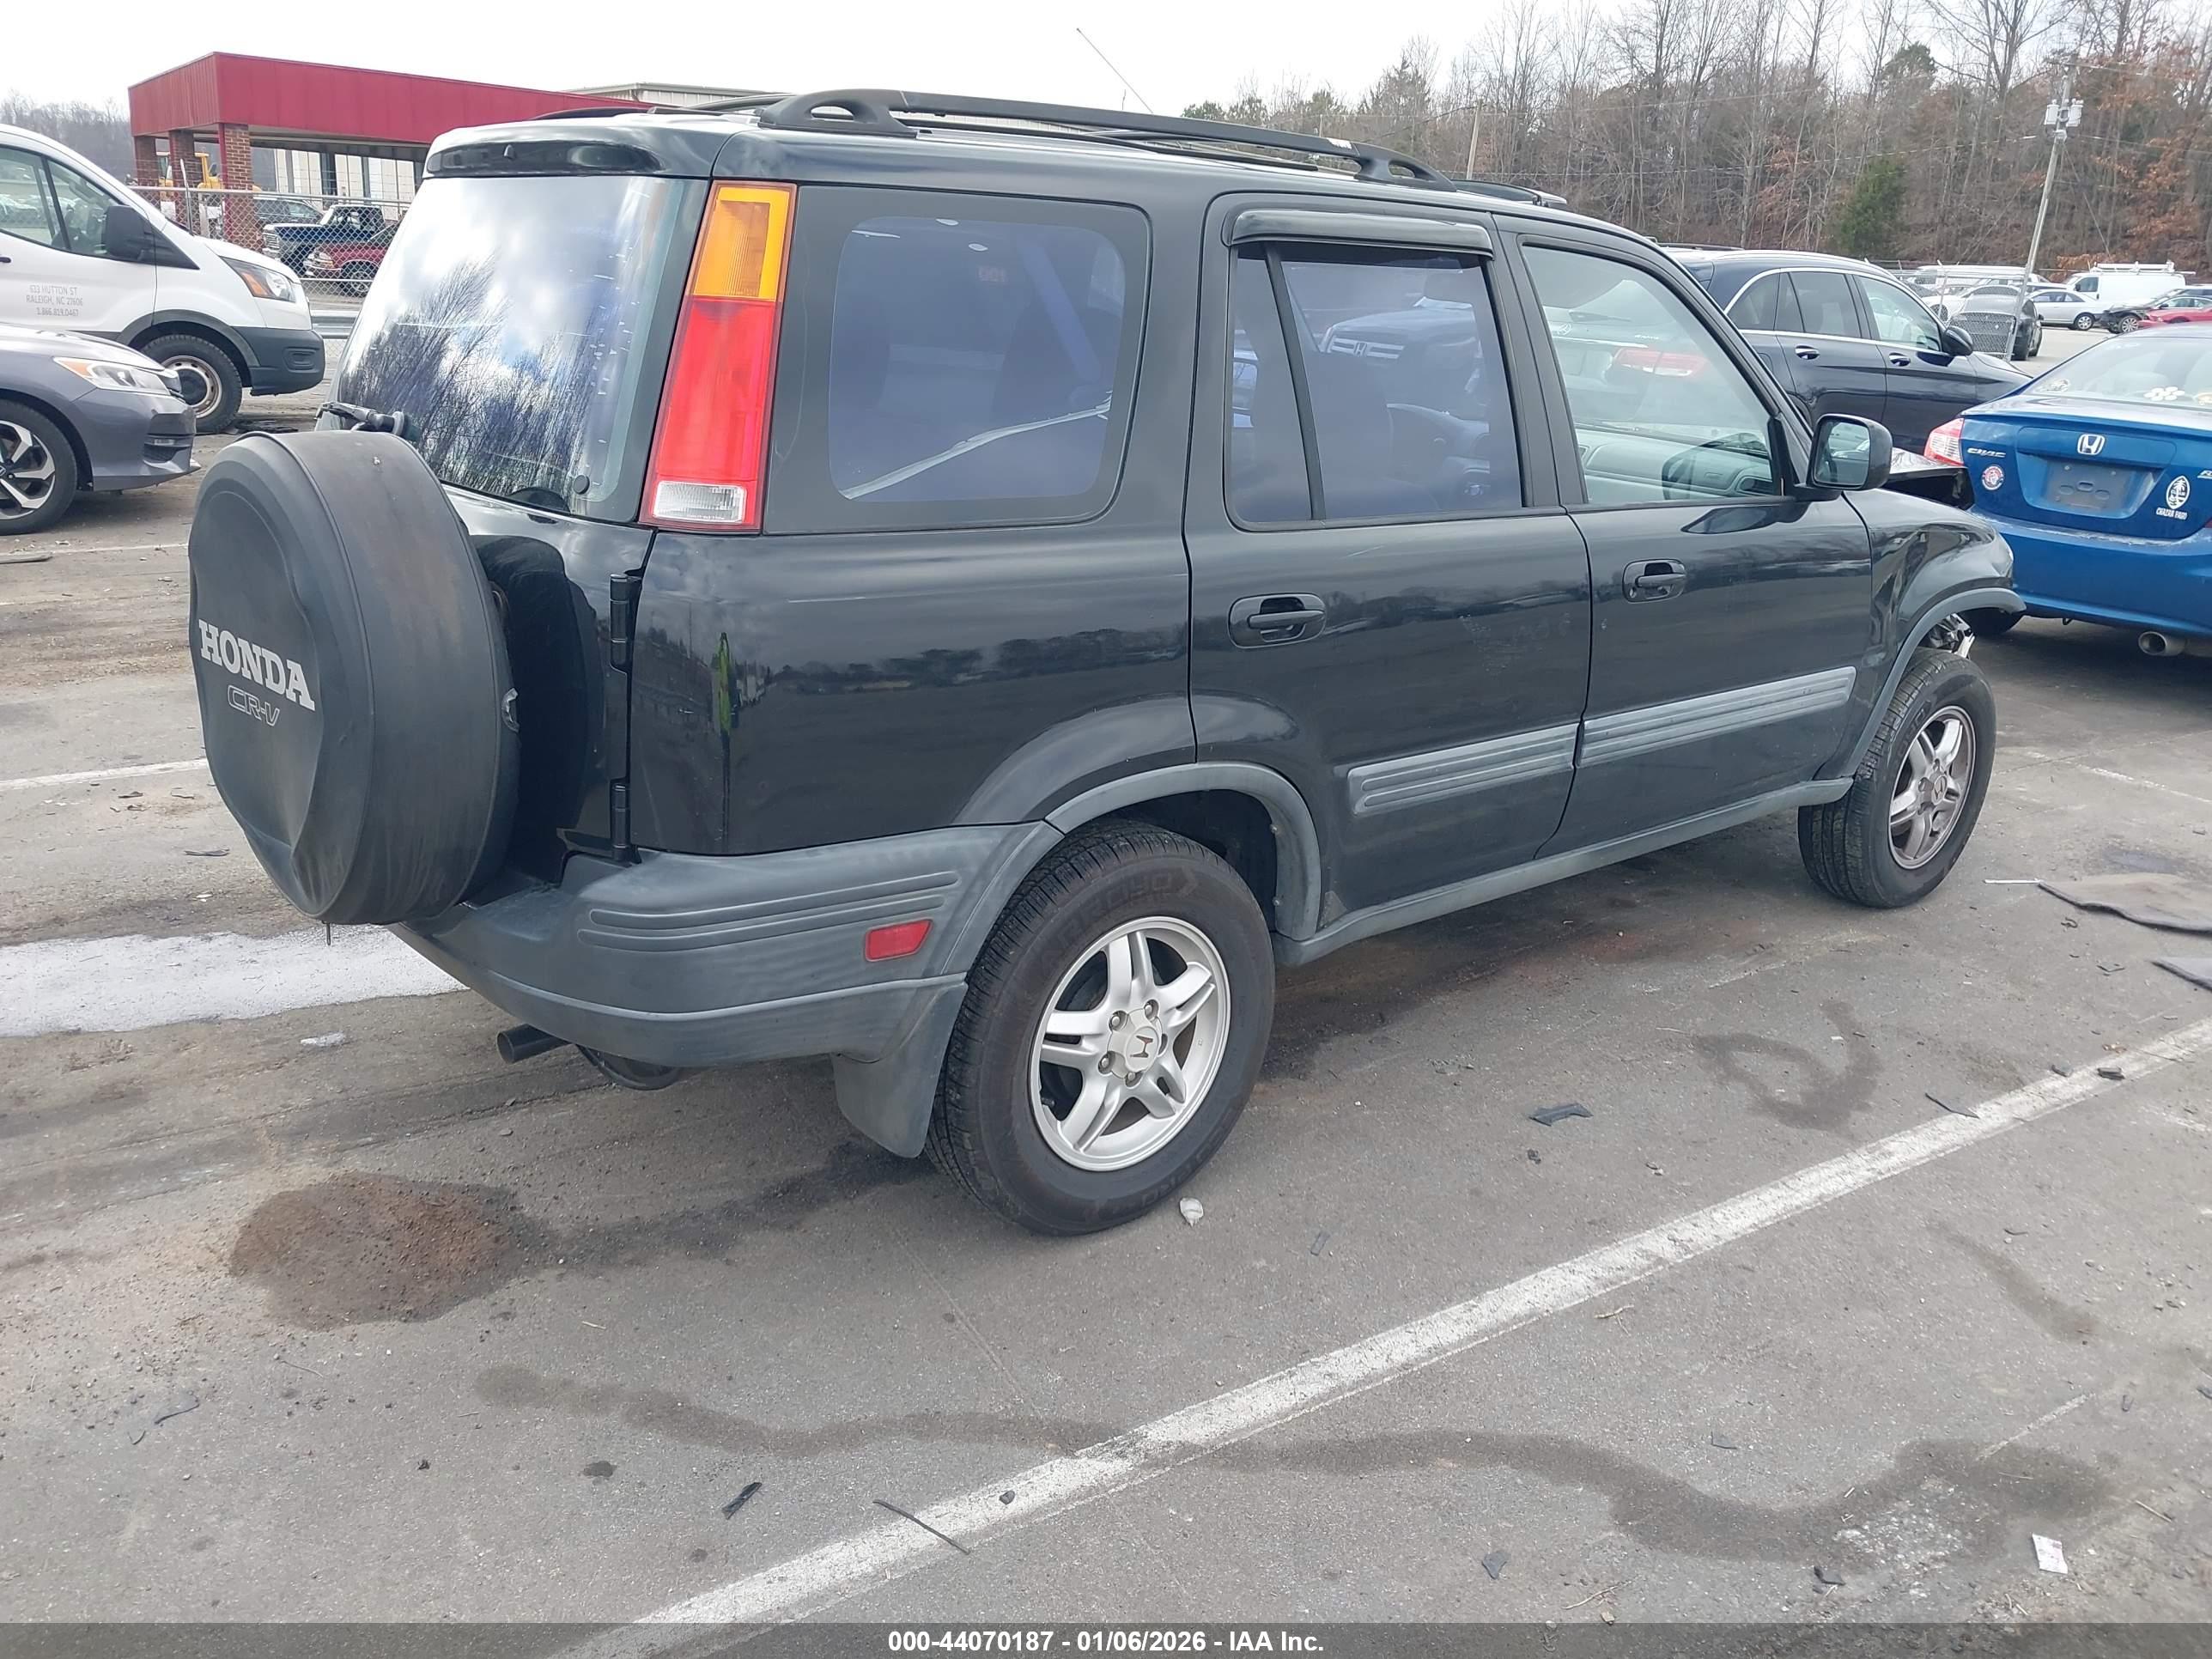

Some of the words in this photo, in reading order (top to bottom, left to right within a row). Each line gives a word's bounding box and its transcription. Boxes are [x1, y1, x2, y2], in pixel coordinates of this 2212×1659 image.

[56, 296, 65, 306] NC
[70, 287, 78, 296] ST
[198, 618, 316, 711] HONDA
[228, 684, 280, 726] CR-V
